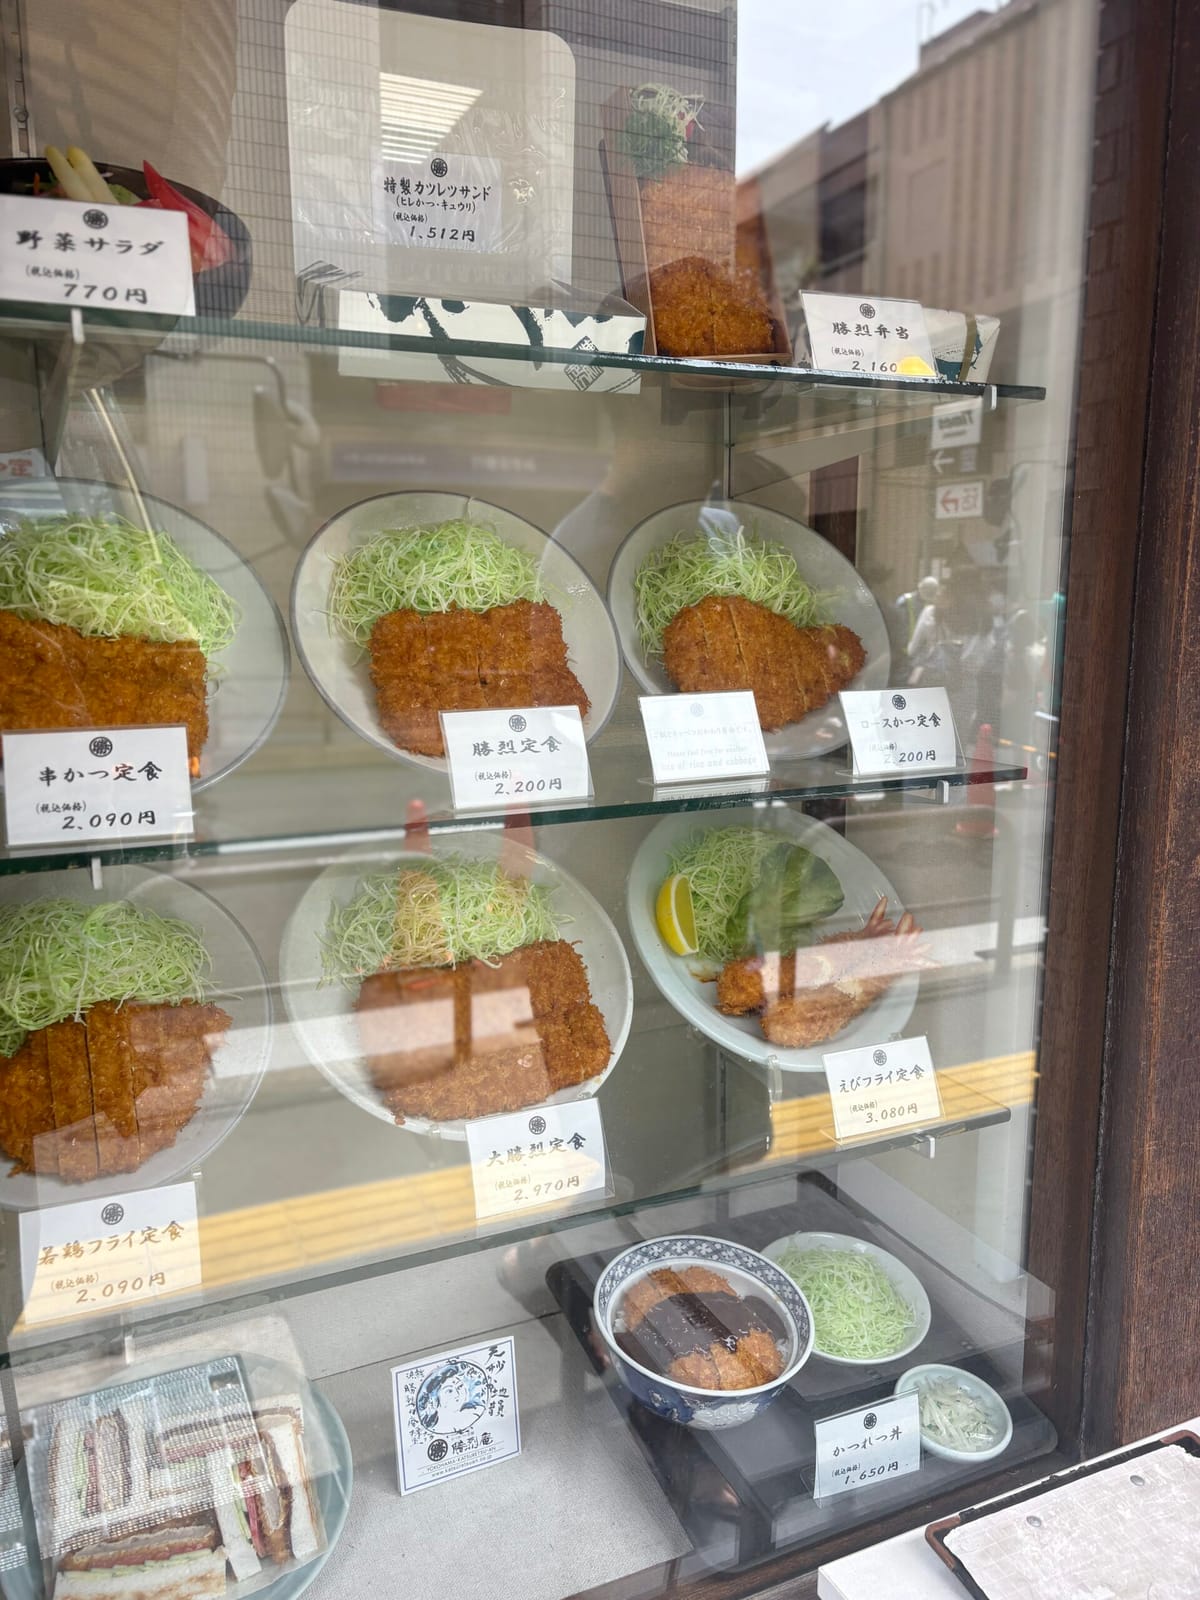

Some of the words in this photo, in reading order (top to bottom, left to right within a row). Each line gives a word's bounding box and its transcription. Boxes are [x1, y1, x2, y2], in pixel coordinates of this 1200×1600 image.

[383, 176, 491, 200] 特製カツレツサンド
[16, 230, 164, 255] 野菜サラダ
[63, 284, 148, 304] 770円
[831, 321, 910, 340] 勝烈弁当
[860, 712, 942, 728] ロースかつ定食
[472, 736, 562, 756] 勝烈定食
[39, 761, 163, 787] 串かつ定食
[475, 769, 512, 782] (税込価格)
[36, 800, 87, 814] (税込価格)
[839, 1064, 925, 1093] えびフライ定食
[486, 1132, 586, 1167] 大勝烈定食
[38, 1220, 185, 1266] 若鶏フライ定食
[832, 1425, 902, 1457] かつれつ丼
